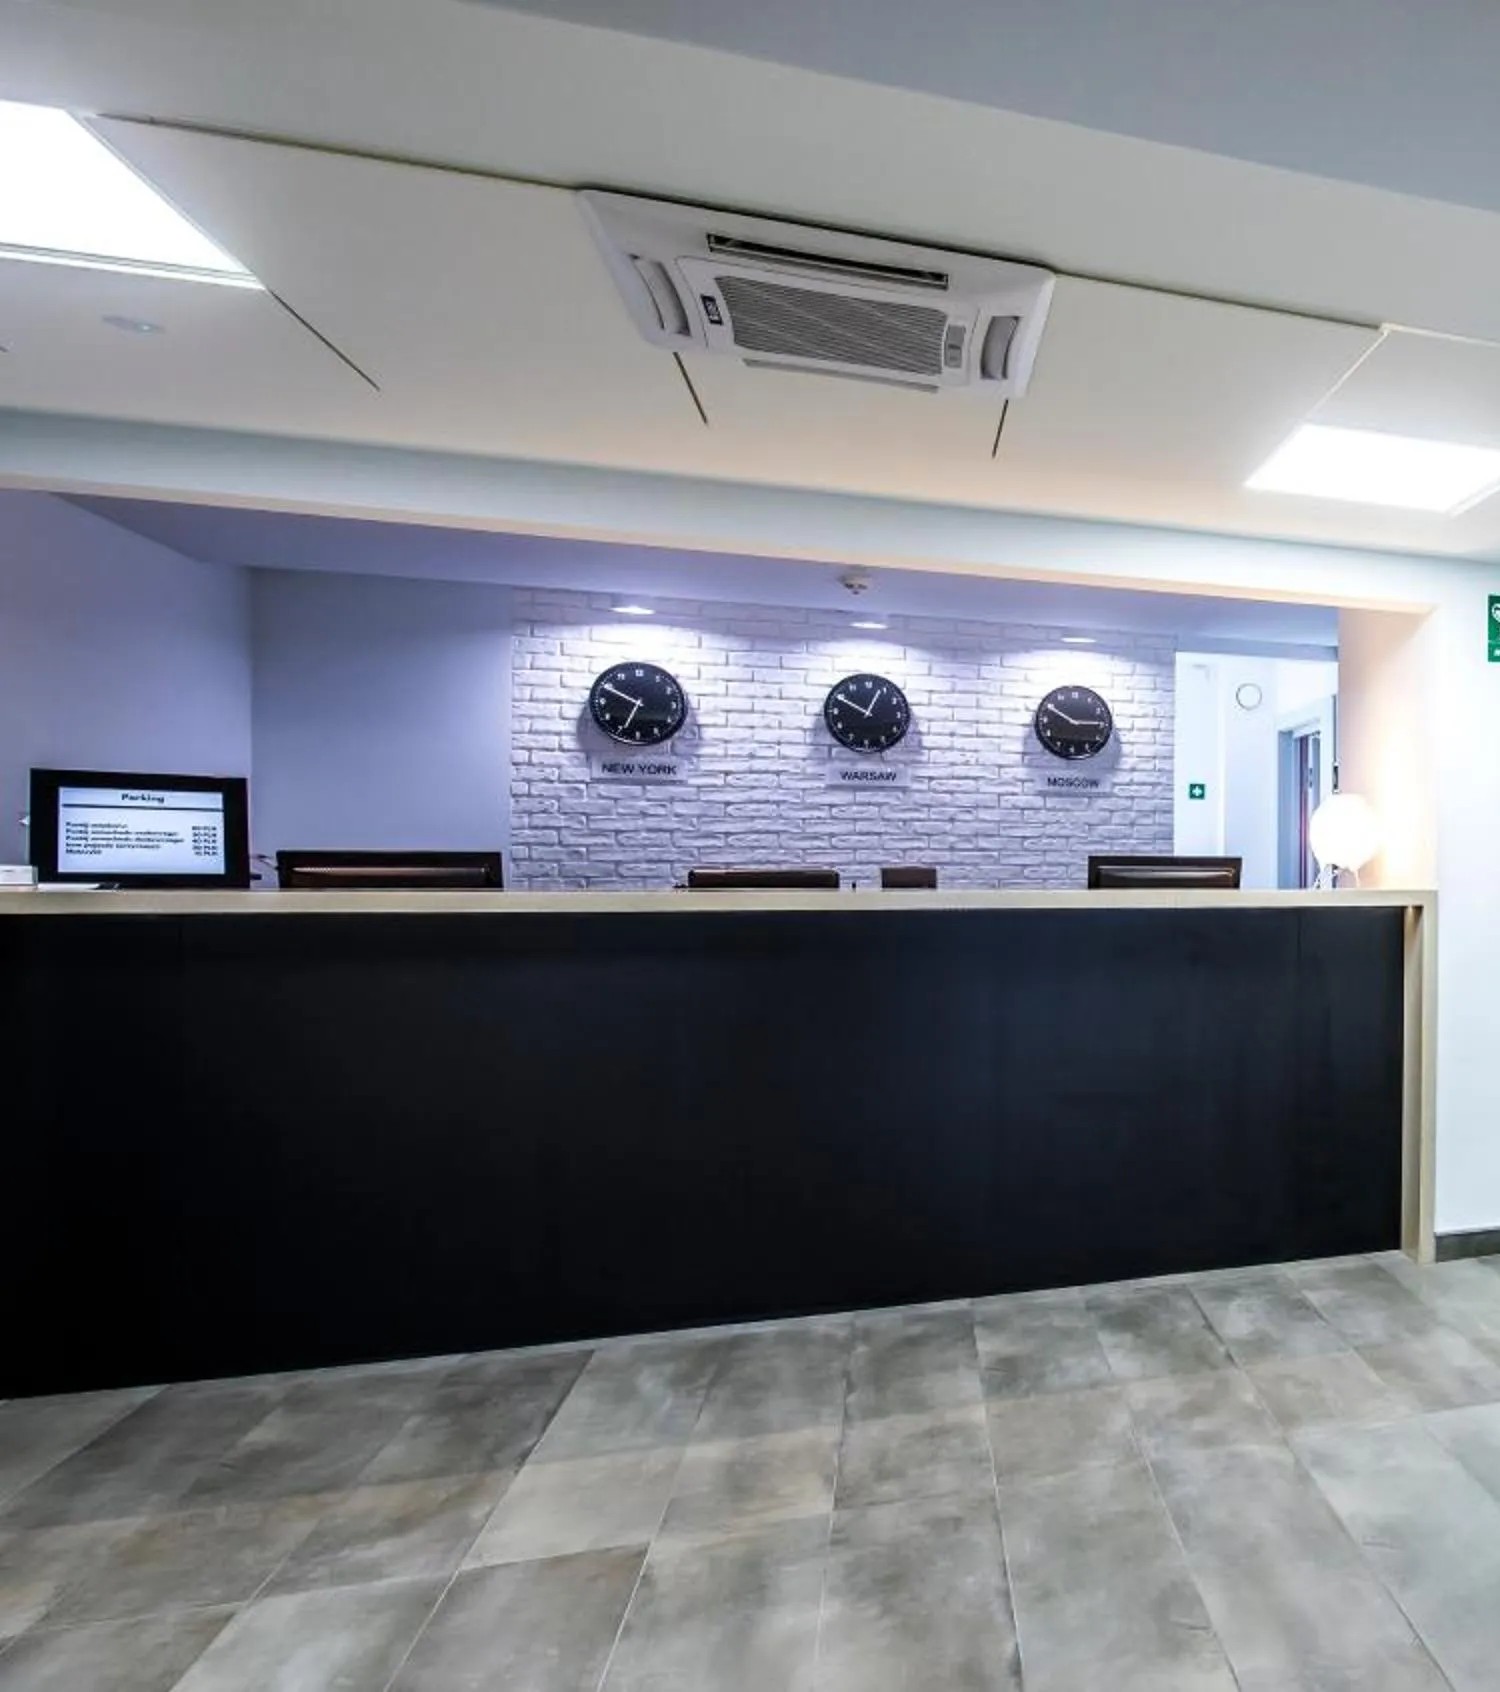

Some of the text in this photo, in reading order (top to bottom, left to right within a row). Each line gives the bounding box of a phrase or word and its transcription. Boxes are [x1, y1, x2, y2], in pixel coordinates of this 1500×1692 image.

[601, 763, 677, 775] NEW YORK
[839, 771, 897, 782] WARSAW
[1047, 777, 1099, 788] MOSCOW
[121, 793, 165, 804] Parking
